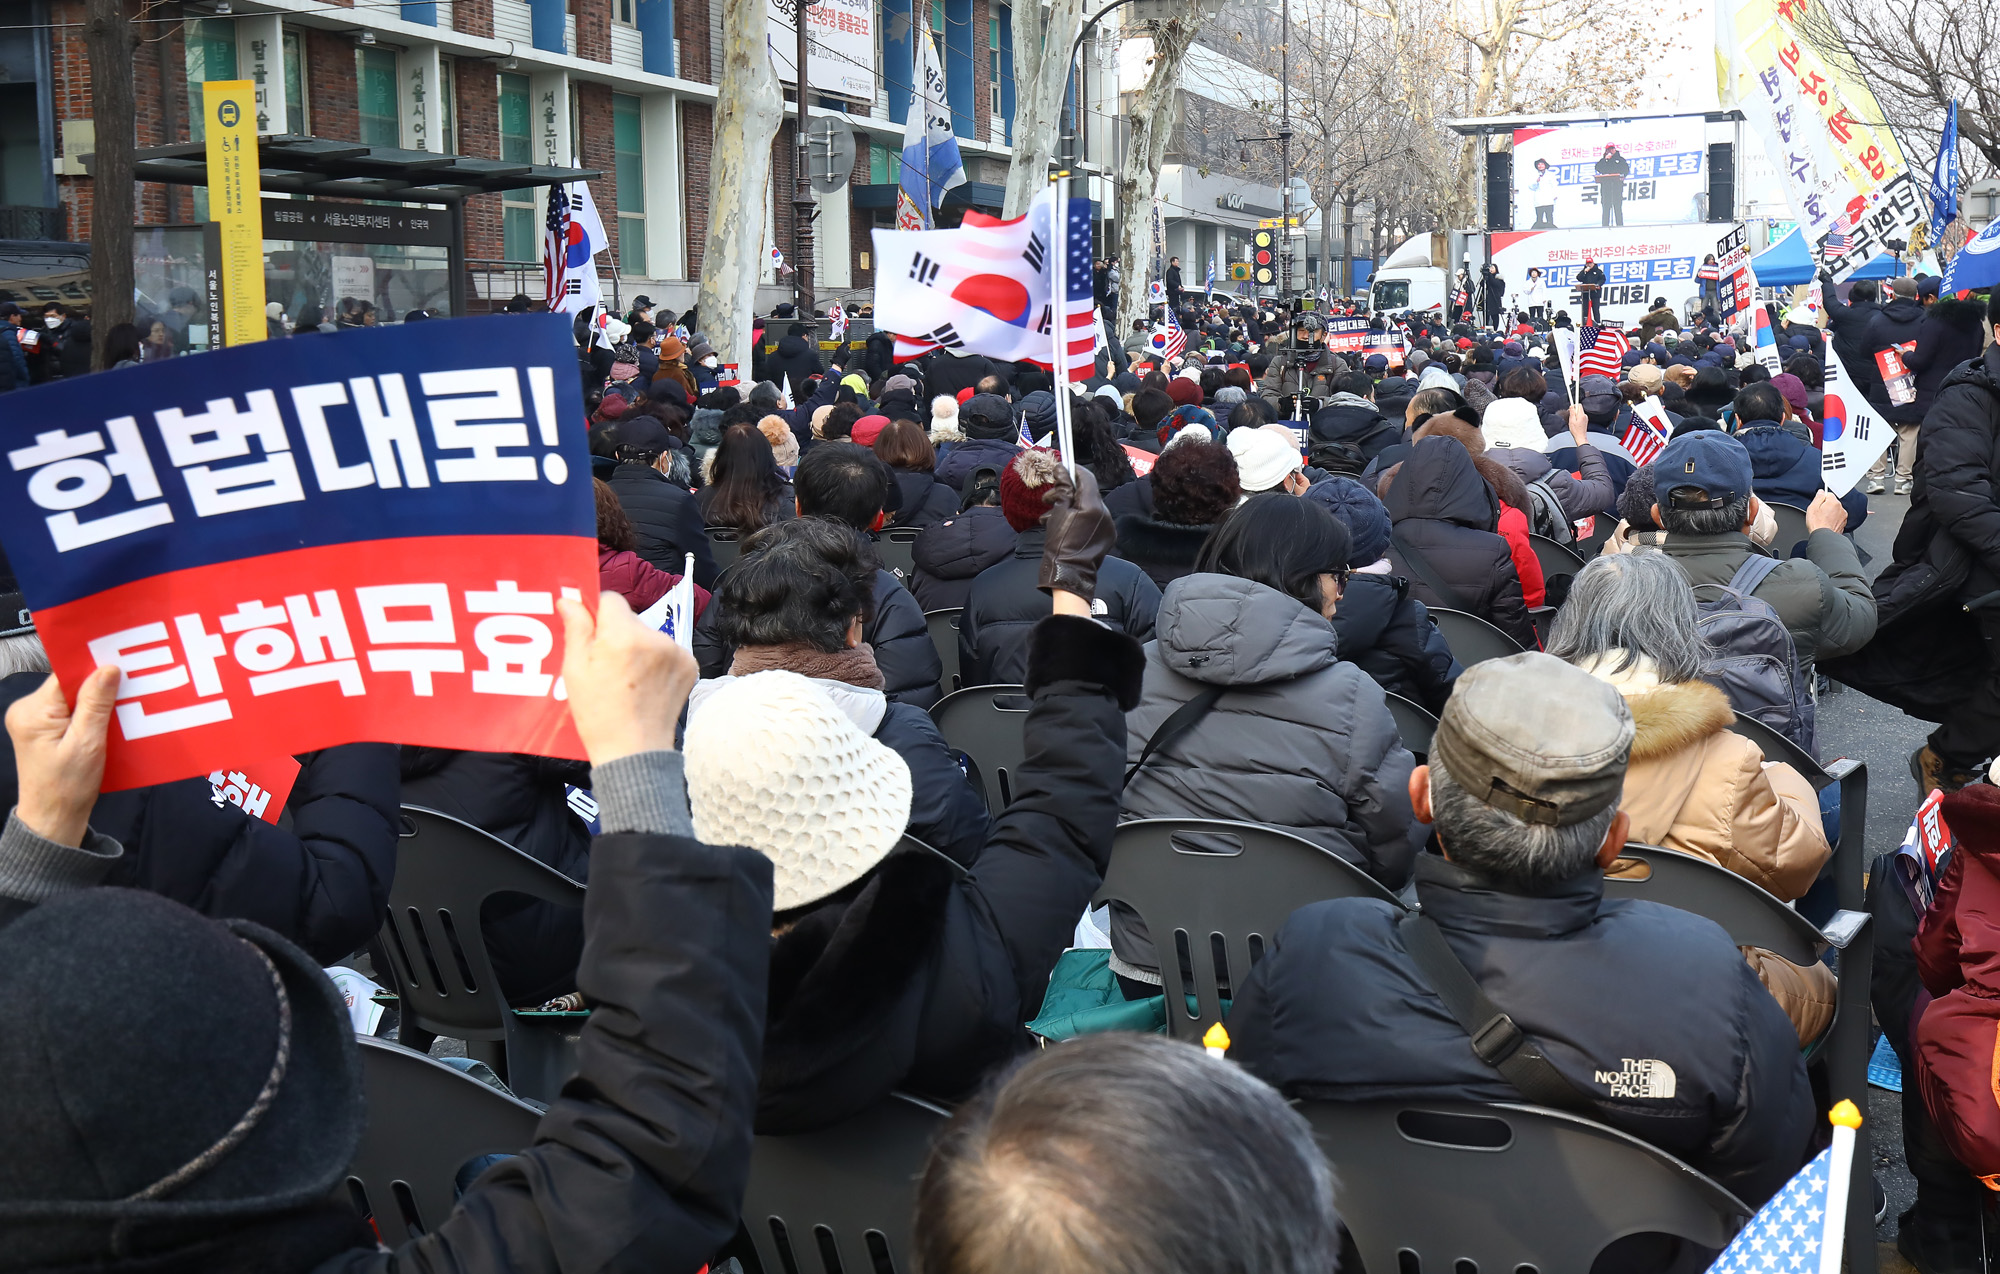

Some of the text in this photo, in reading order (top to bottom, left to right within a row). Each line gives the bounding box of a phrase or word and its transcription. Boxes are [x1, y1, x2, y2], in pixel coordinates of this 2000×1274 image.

[838, 11, 870, 36] 출품공모
[1561, 139, 1677, 159] 헌재는 법주의 수호하라!
[1658, 153, 1699, 176] 무효
[1581, 180, 1656, 205] 국대회
[274, 211, 430, 230] 탑골공원 서울노인복지센터 안국역
[1718, 226, 1746, 256] 이재명
[1548, 243, 1671, 261] 헌재는 법치주의 수호하라!
[1609, 261, 1648, 283] 탄핵
[1652, 258, 1692, 280] 무효
[1720, 282, 1734, 298] 명분
[1721, 295, 1735, 312] 실종
[1328, 319, 1371, 332] 헌법대로!
[1329, 335, 1365, 348] 탄핵무
[1363, 333, 1403, 346] 헌법대로!
[8, 365, 569, 553] 헌법대로!
[1621, 1058, 1653, 1072] THE
[1594, 1070, 1651, 1085] NORTH
[1610, 1084, 1651, 1098] FACE
